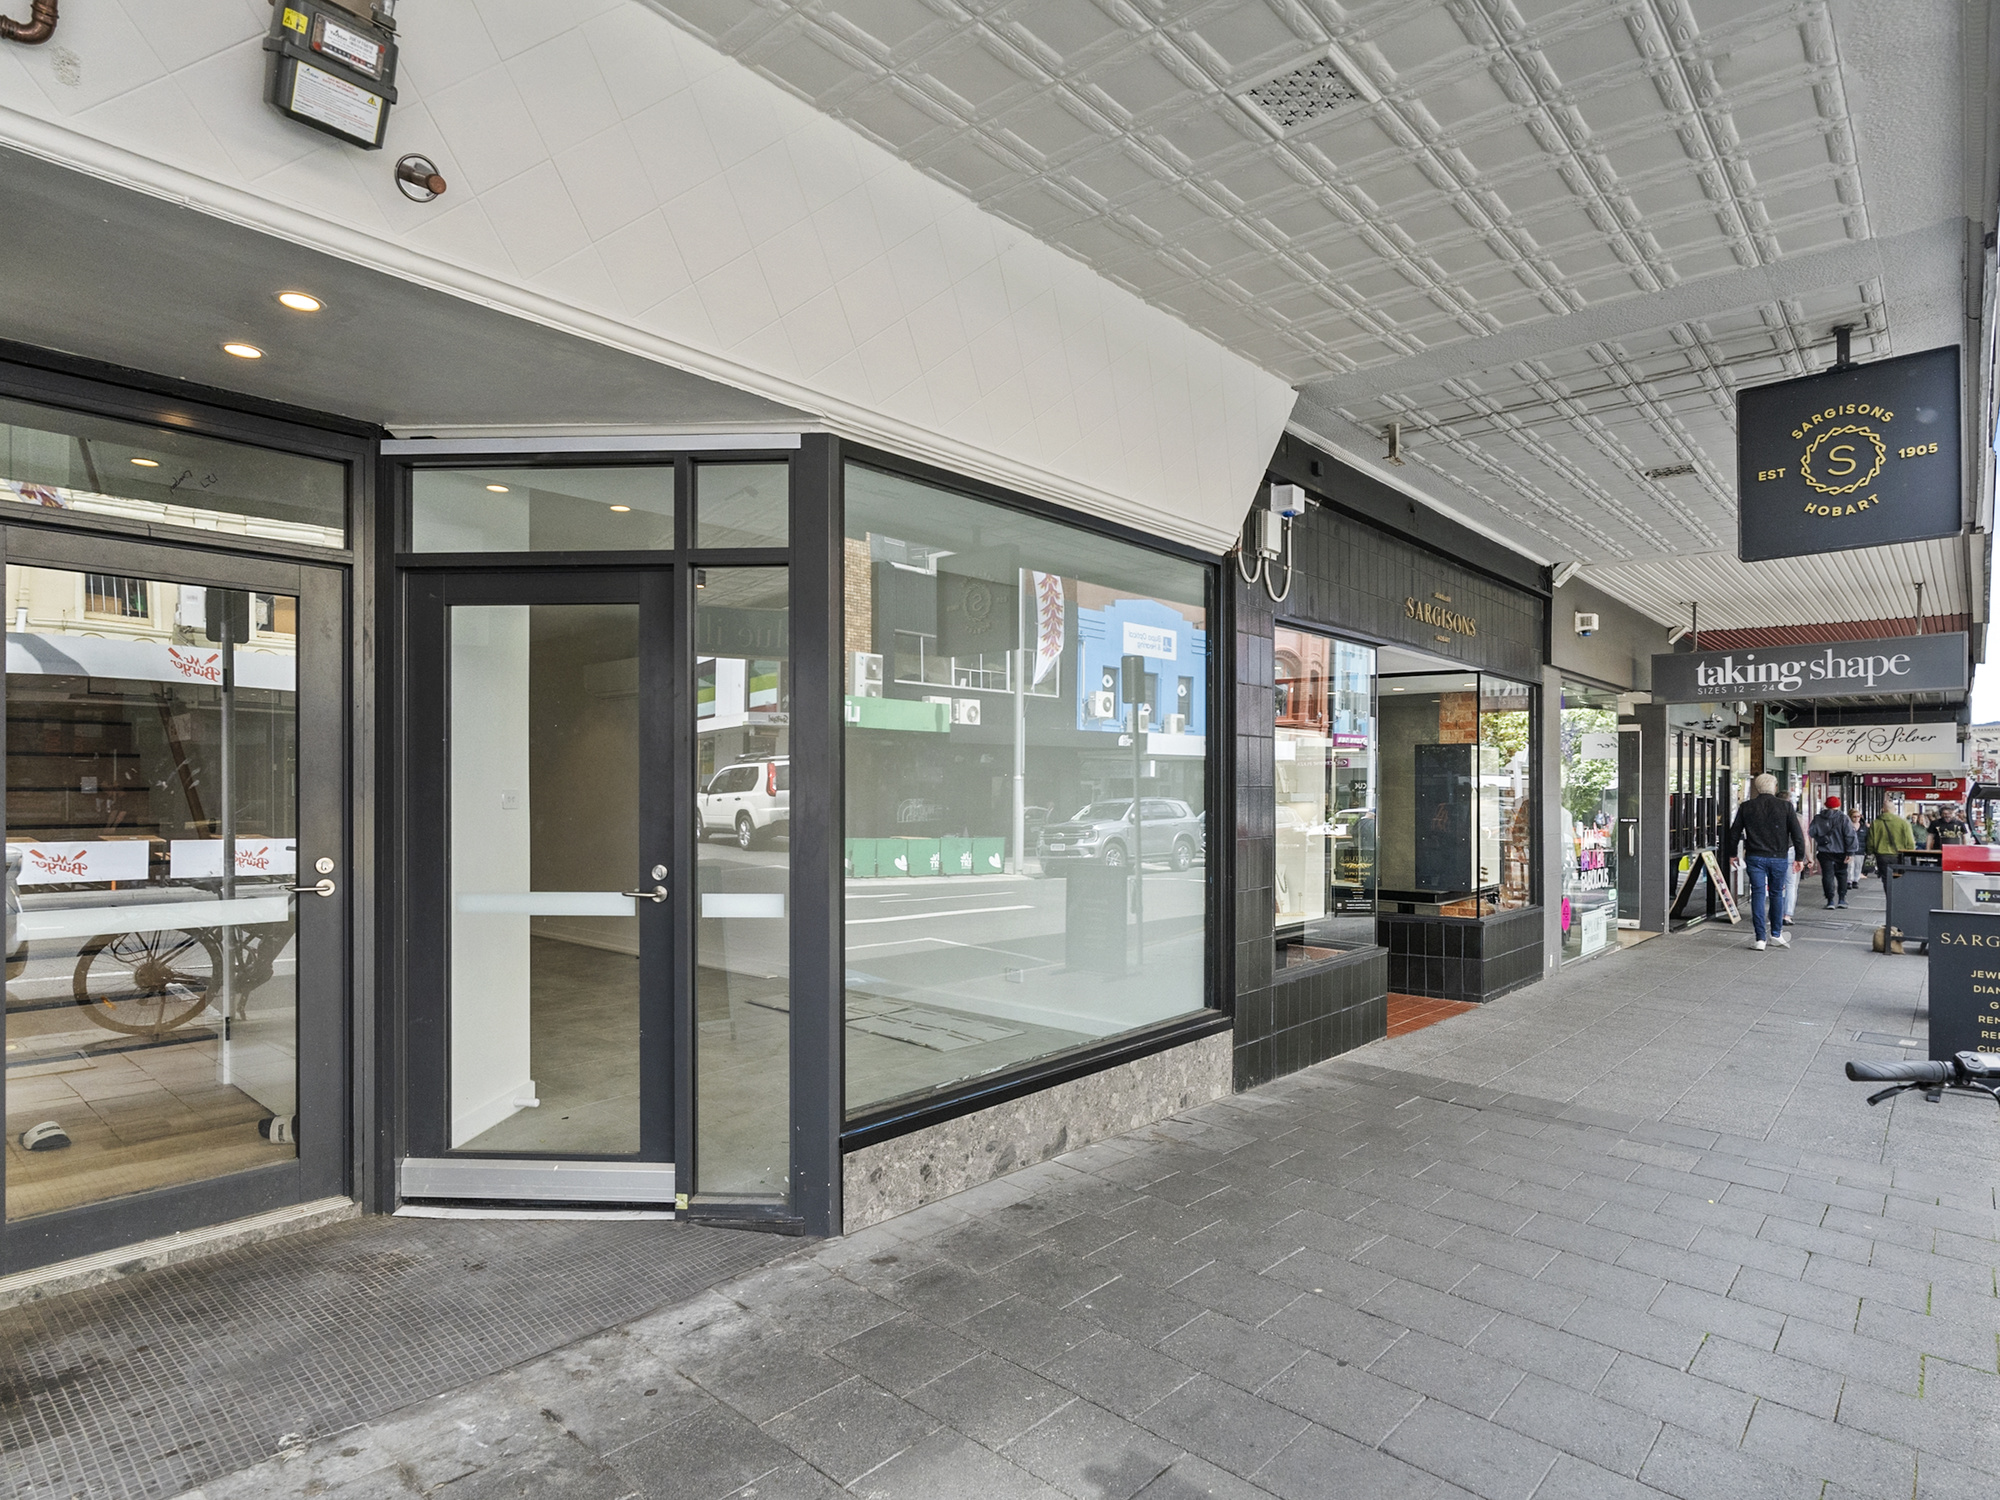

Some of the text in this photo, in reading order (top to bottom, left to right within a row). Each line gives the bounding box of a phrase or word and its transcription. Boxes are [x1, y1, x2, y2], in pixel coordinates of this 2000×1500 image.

[1791, 403, 1895, 440] SARGISONS
[1758, 442, 1938, 482] EST 1905
[1827, 444, 1857, 476] S
[1804, 493, 1881, 517] HOBART
[1405, 596, 1476, 638] SARGISONS
[1695, 648, 1911, 692] taking shape
[1697, 686, 1727, 695] SIZES
[1733, 685, 1744, 693] 12
[1762, 683, 1775, 692] 24
[1793, 726, 1937, 754] Love of Silver
[1827, 727, 1856, 737] For the
[1855, 753, 1908, 762] RENATA
[1940, 932, 2000, 948] SARG
[1970, 970, 2000, 980] JEW
[1981, 1030, 2000, 1040] RE
